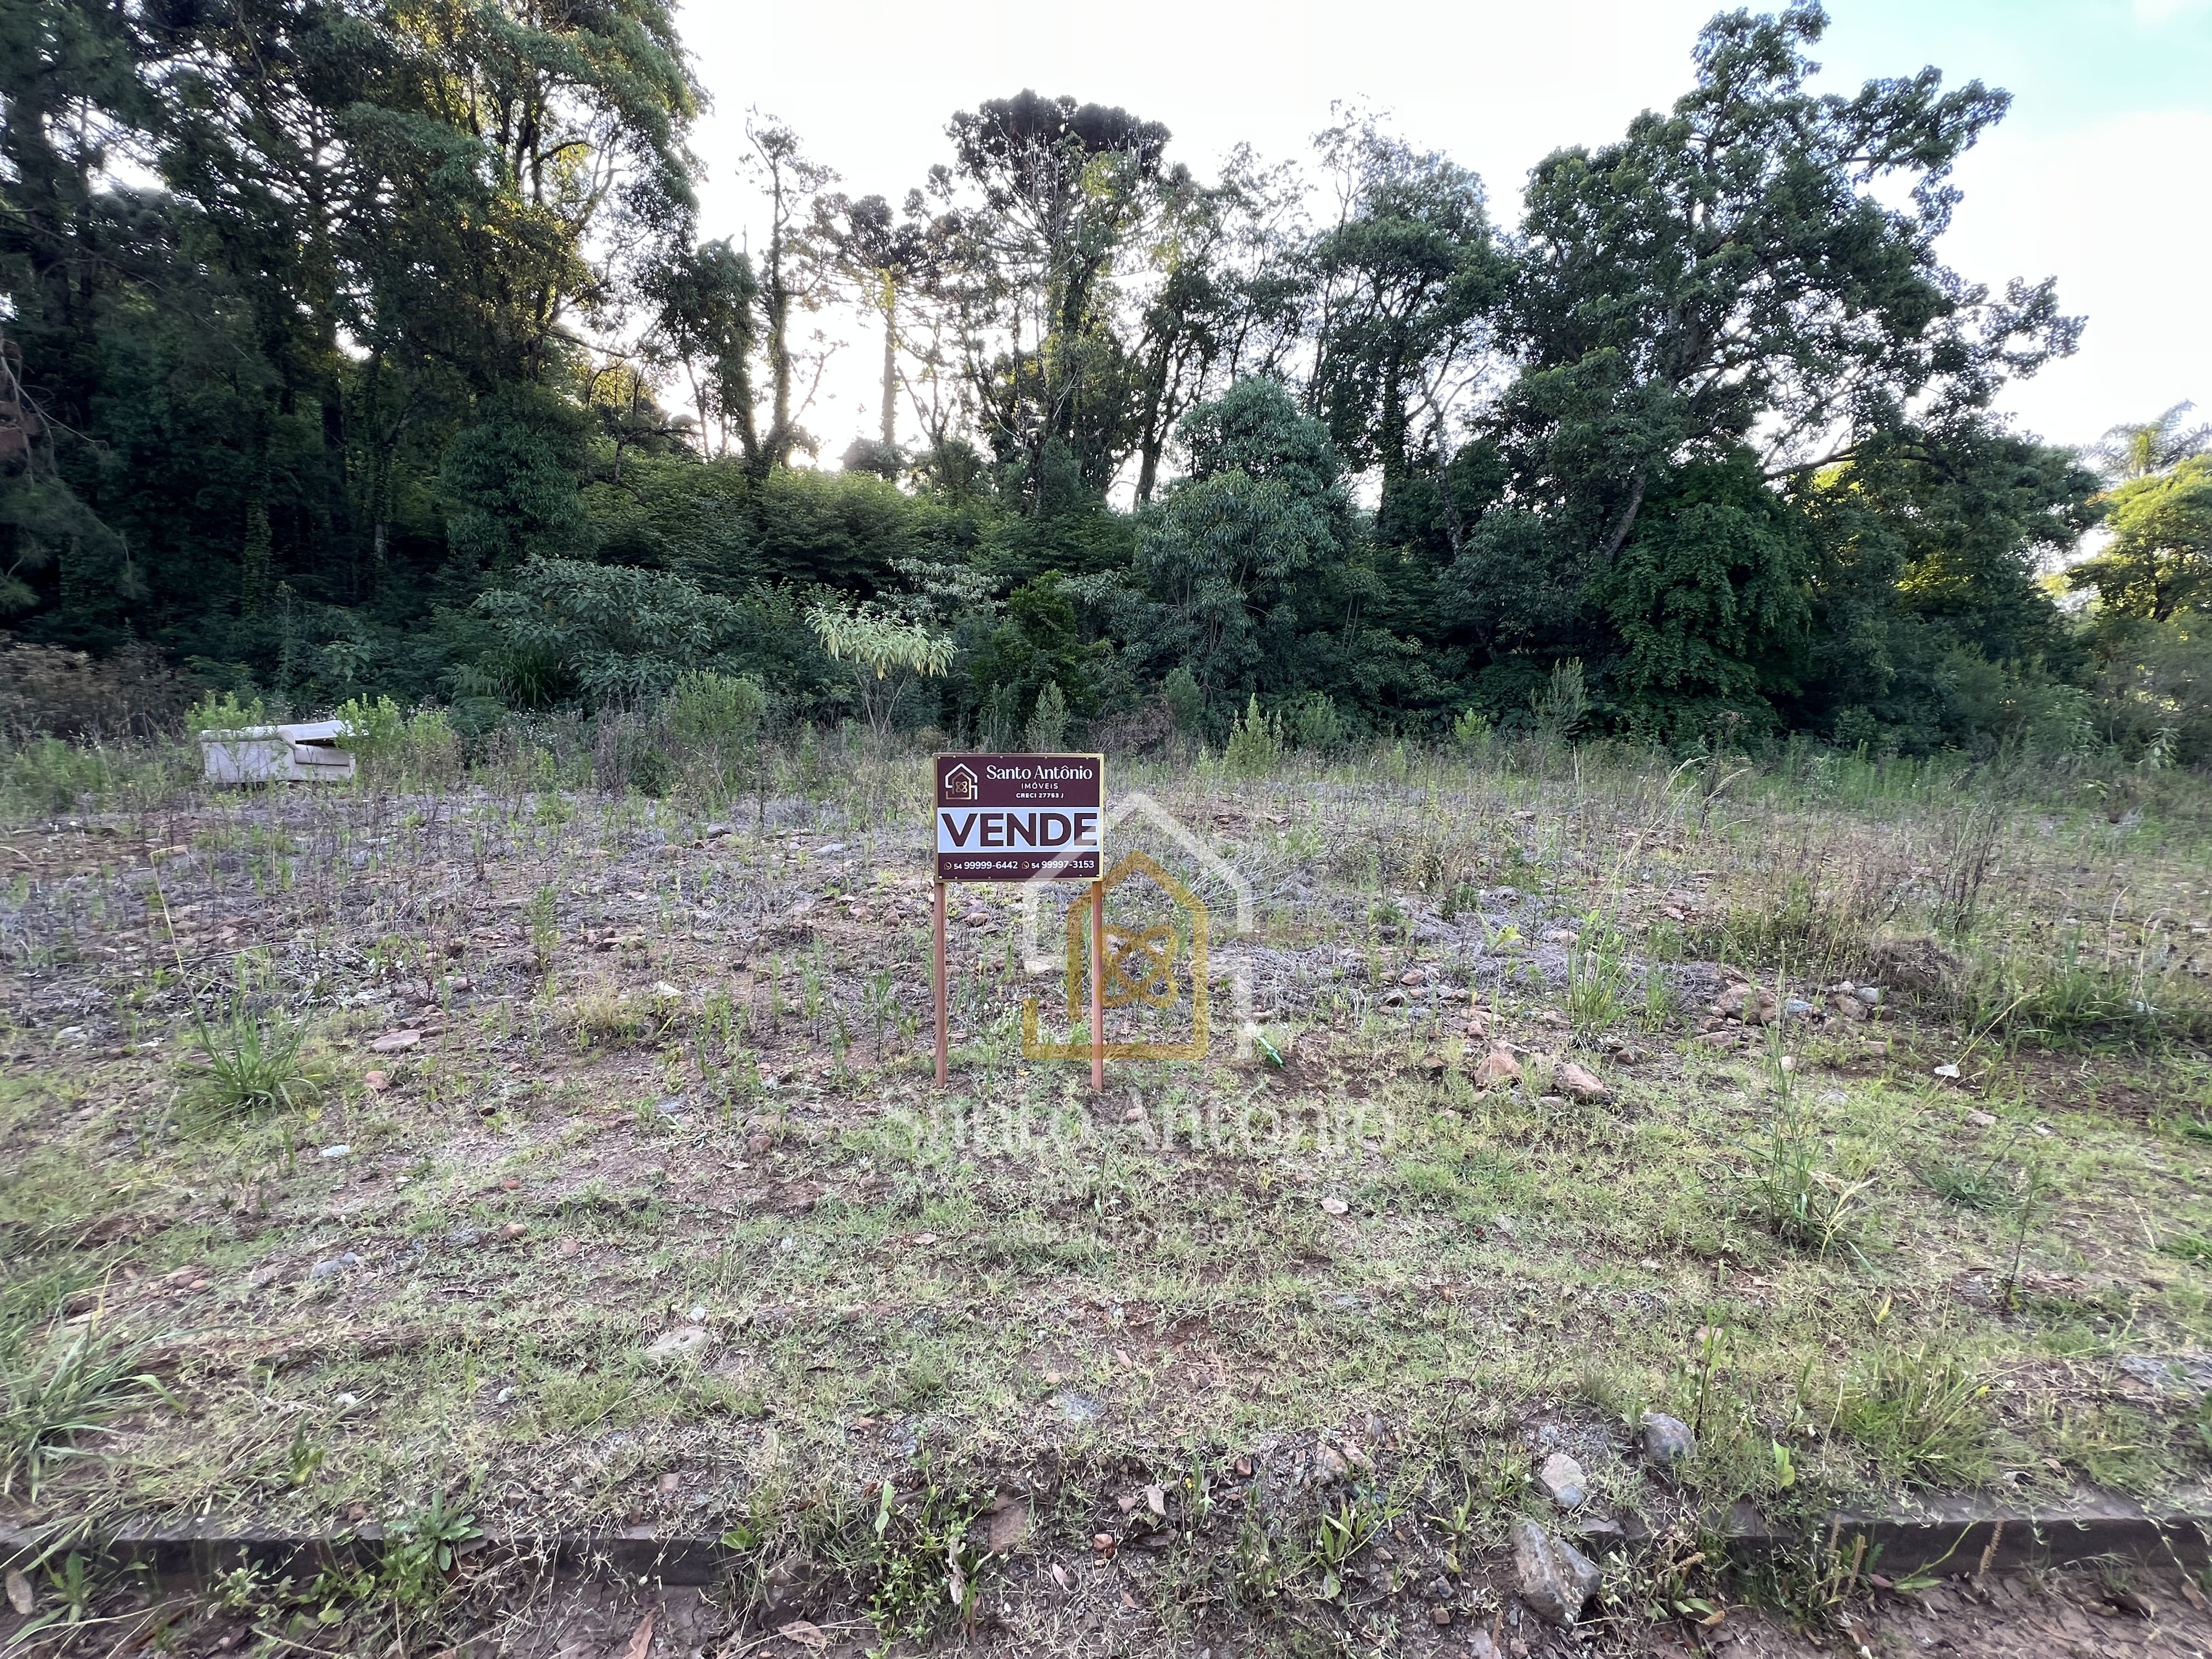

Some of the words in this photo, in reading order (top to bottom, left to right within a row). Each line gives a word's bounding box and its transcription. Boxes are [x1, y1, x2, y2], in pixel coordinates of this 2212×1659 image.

[987, 765, 1031, 780] Santo
[1034, 765, 1093, 780] Antônio
[1021, 781, 1058, 789] IMÓVEIS
[941, 813, 1097, 847] VENDE
[1041, 860, 1094, 868] 99997-3153
